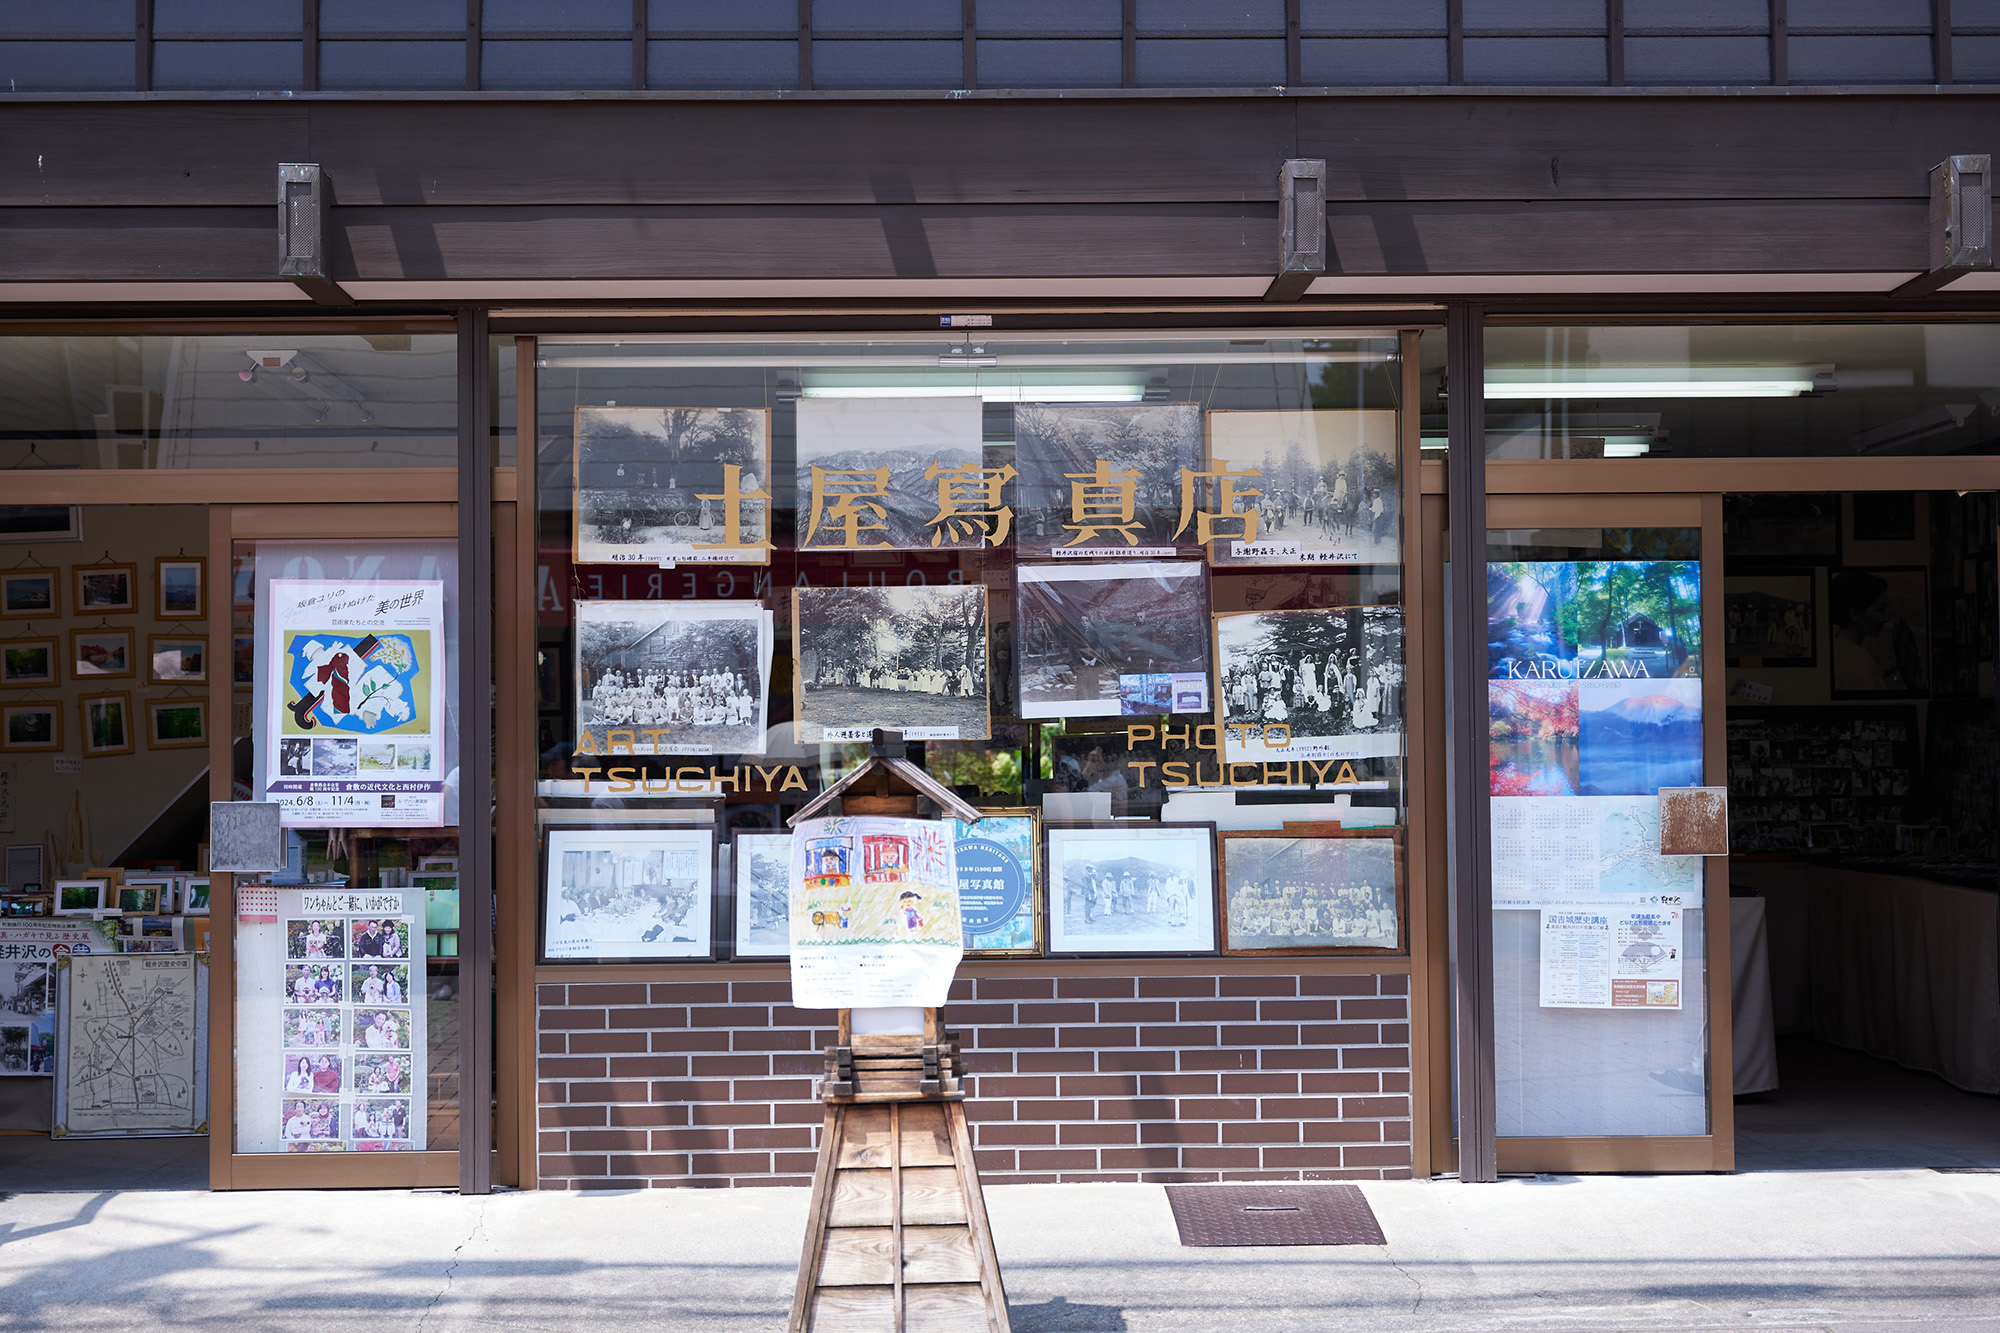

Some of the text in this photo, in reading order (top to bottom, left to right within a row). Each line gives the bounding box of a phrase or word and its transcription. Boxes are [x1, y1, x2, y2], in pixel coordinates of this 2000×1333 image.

[374, 589, 425, 616] 美の世界
[1508, 660, 1650, 679] KARUIZAWA
[572, 728, 671, 756] ART
[1127, 723, 1291, 750] PHOTO
[346, 783, 432, 791] 倉敷の近代文化と西村伊作
[572, 765, 808, 793] TSUCHIYA
[1127, 759, 1360, 788] TSUCHIYA
[365, 895, 400, 912] いかがですか
